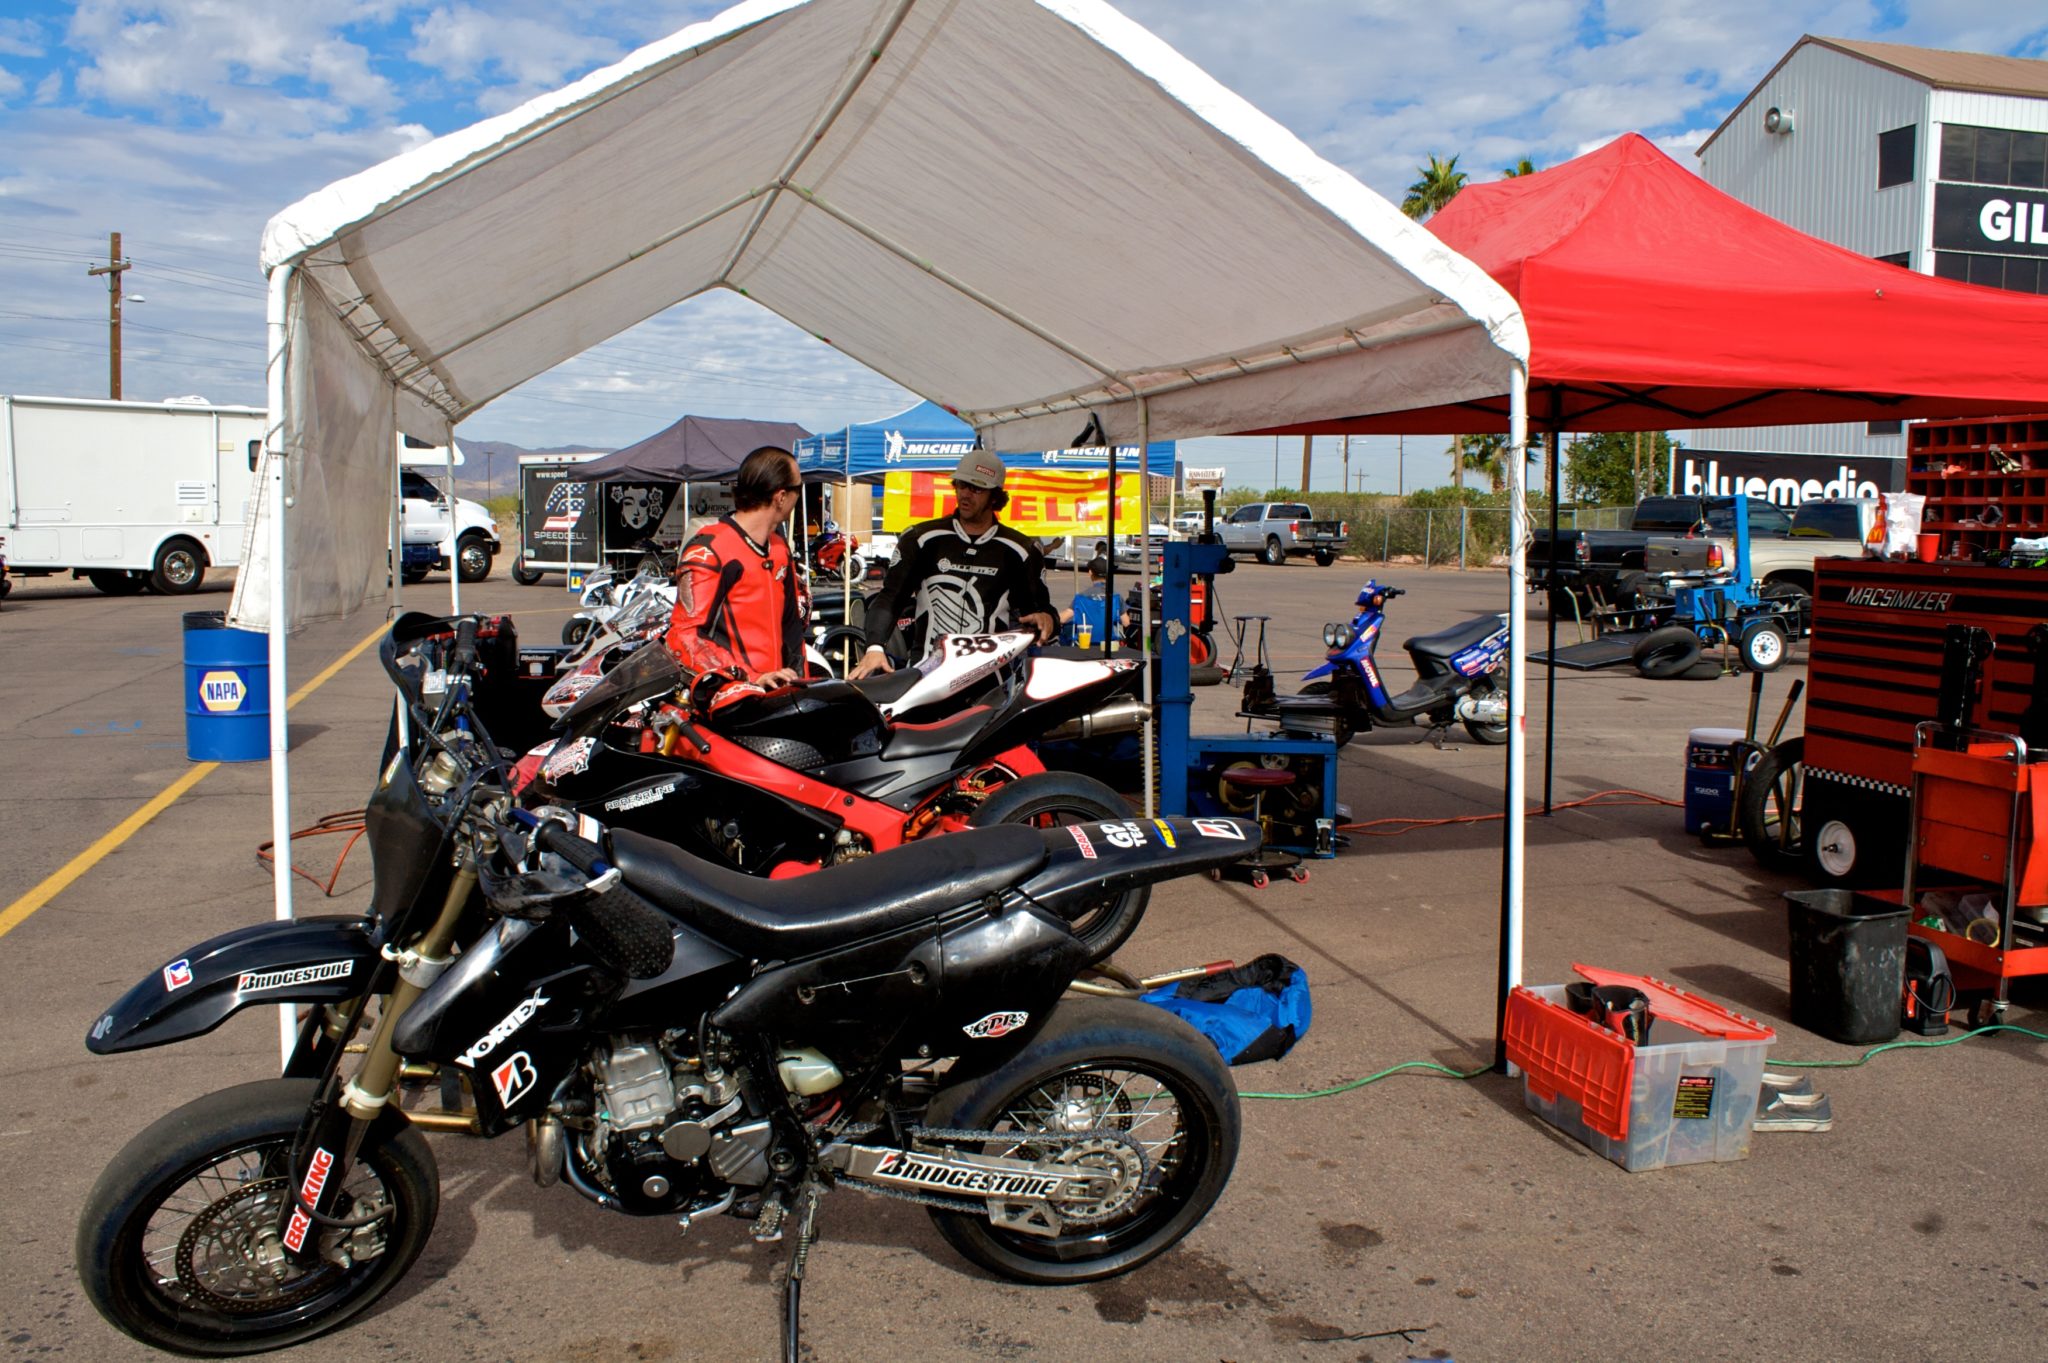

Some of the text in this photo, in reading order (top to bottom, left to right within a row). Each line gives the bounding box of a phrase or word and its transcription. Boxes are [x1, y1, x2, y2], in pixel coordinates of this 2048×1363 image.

[906, 443, 975, 455] MICHELI
[1845, 586, 1952, 611] MACSIMIZER
[951, 635, 998, 658] 35
[1360, 658, 1379, 688] MOTUL
[206, 682, 240, 701] NAPA
[1100, 824, 1133, 848] GP
[238, 960, 353, 993] BRIDGESTONE
[454, 986, 551, 1068] VORTEX
[973, 1013, 1018, 1034] GPR
[879, 1155, 1058, 1196] BRIDGESTONE
